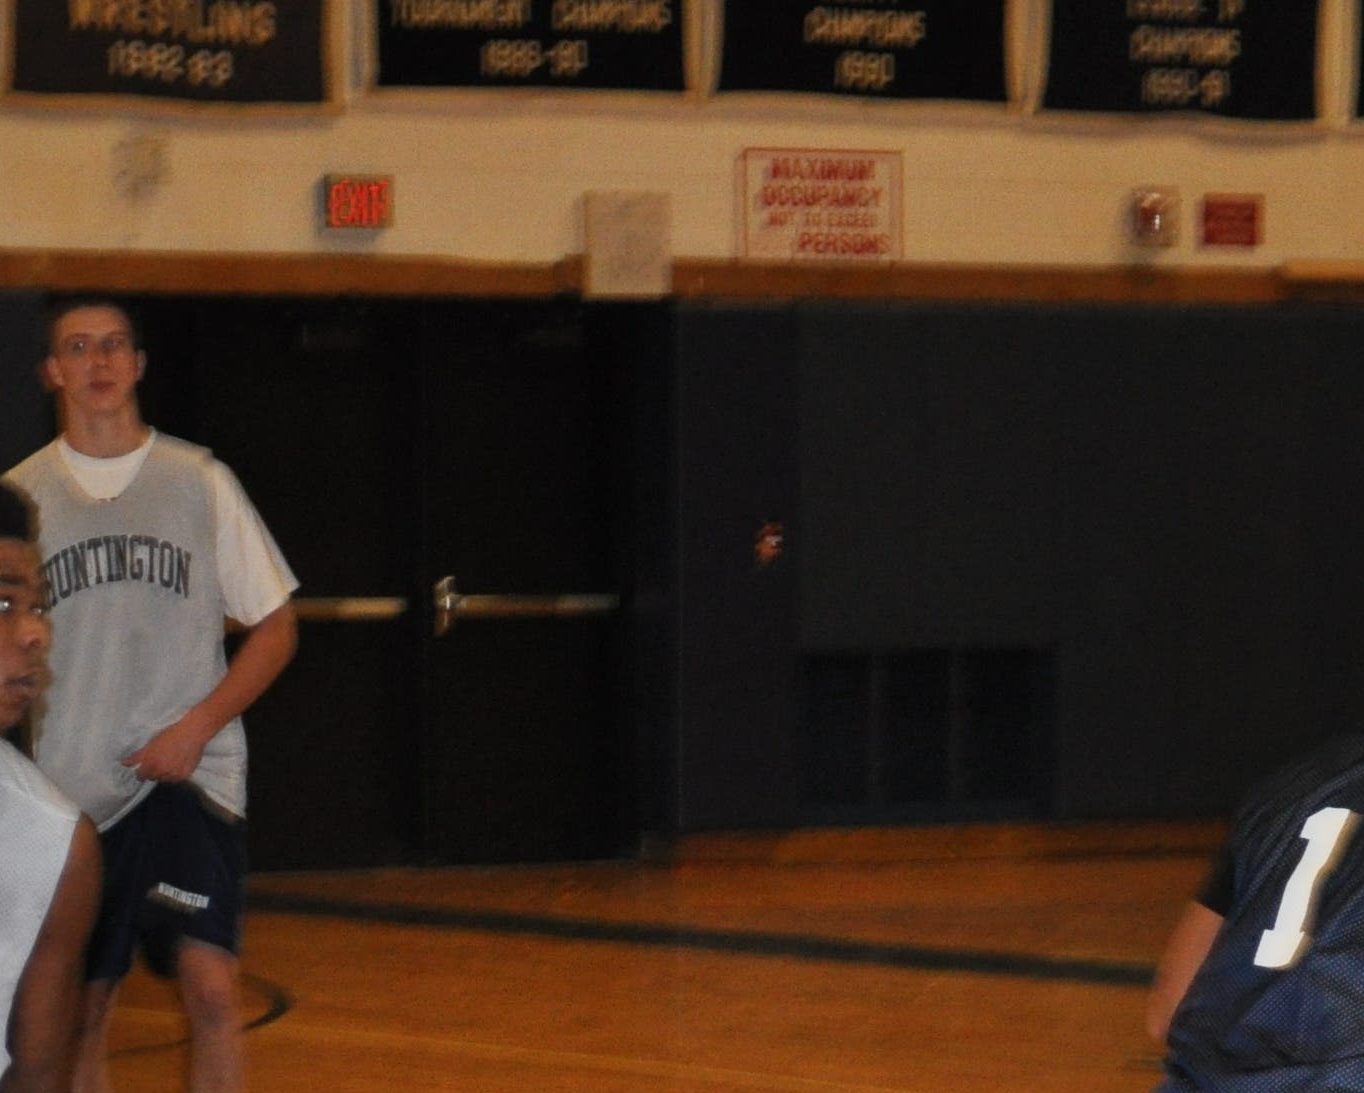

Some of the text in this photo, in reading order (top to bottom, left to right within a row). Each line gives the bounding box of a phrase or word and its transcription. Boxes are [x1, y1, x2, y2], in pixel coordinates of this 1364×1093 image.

[770, 157, 877, 181] MAXIMUM
[329, 177, 391, 227] EXIT
[763, 184, 884, 207] OCCUPANCY
[798, 232, 892, 255] PERSONS
[1253, 805, 1352, 969] 1
